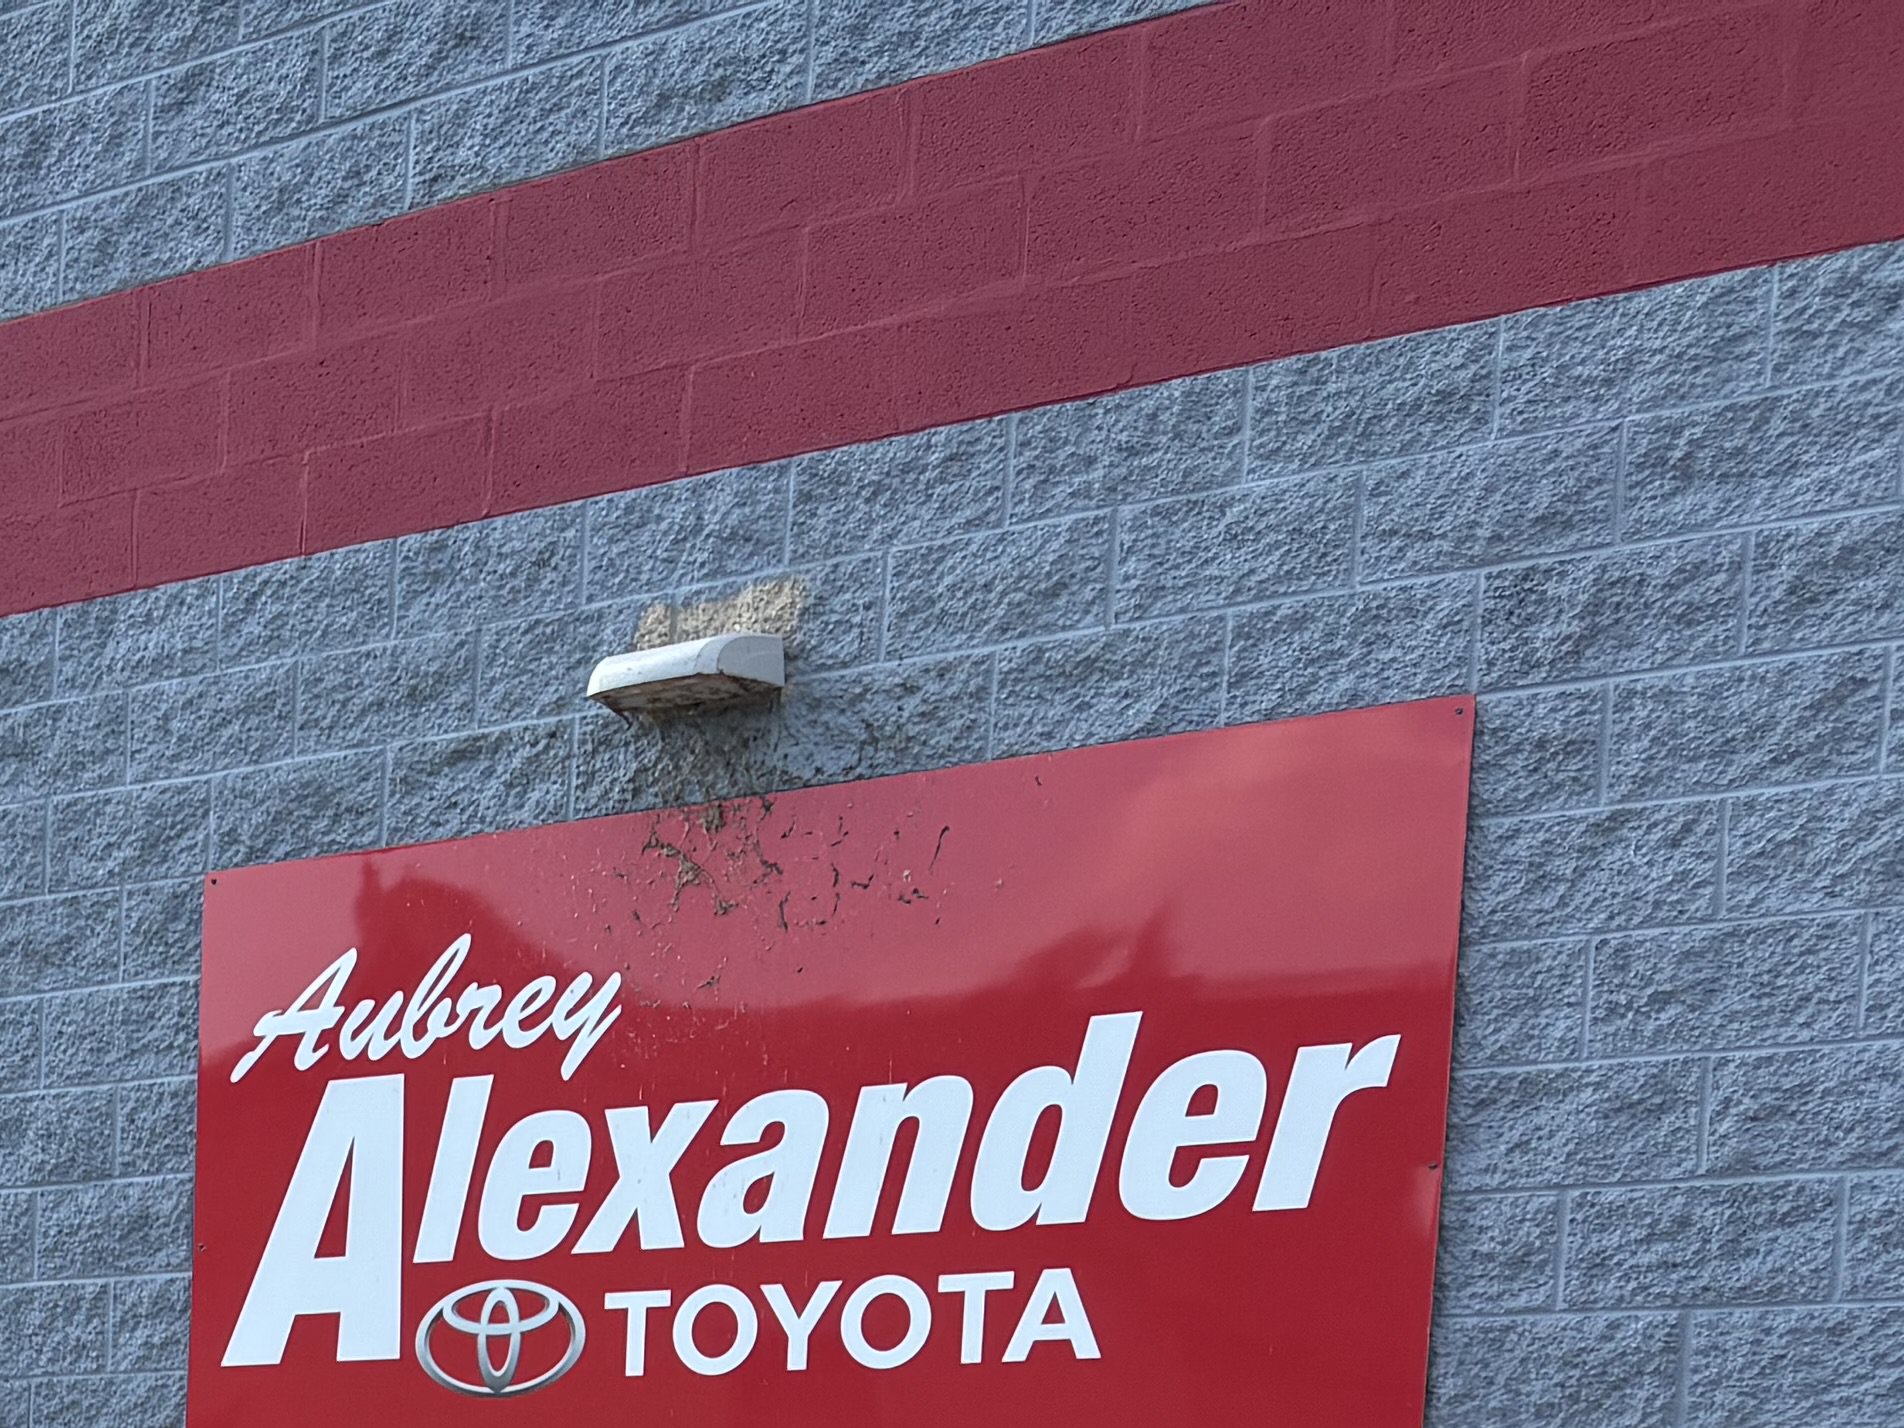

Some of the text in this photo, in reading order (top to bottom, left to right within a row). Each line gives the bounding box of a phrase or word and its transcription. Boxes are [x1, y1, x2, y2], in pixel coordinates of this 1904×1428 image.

[228, 932, 623, 1084] Aubrey
[220, 1010, 1403, 1368] Alexander
[604, 1267, 1102, 1377] TOYOTA
